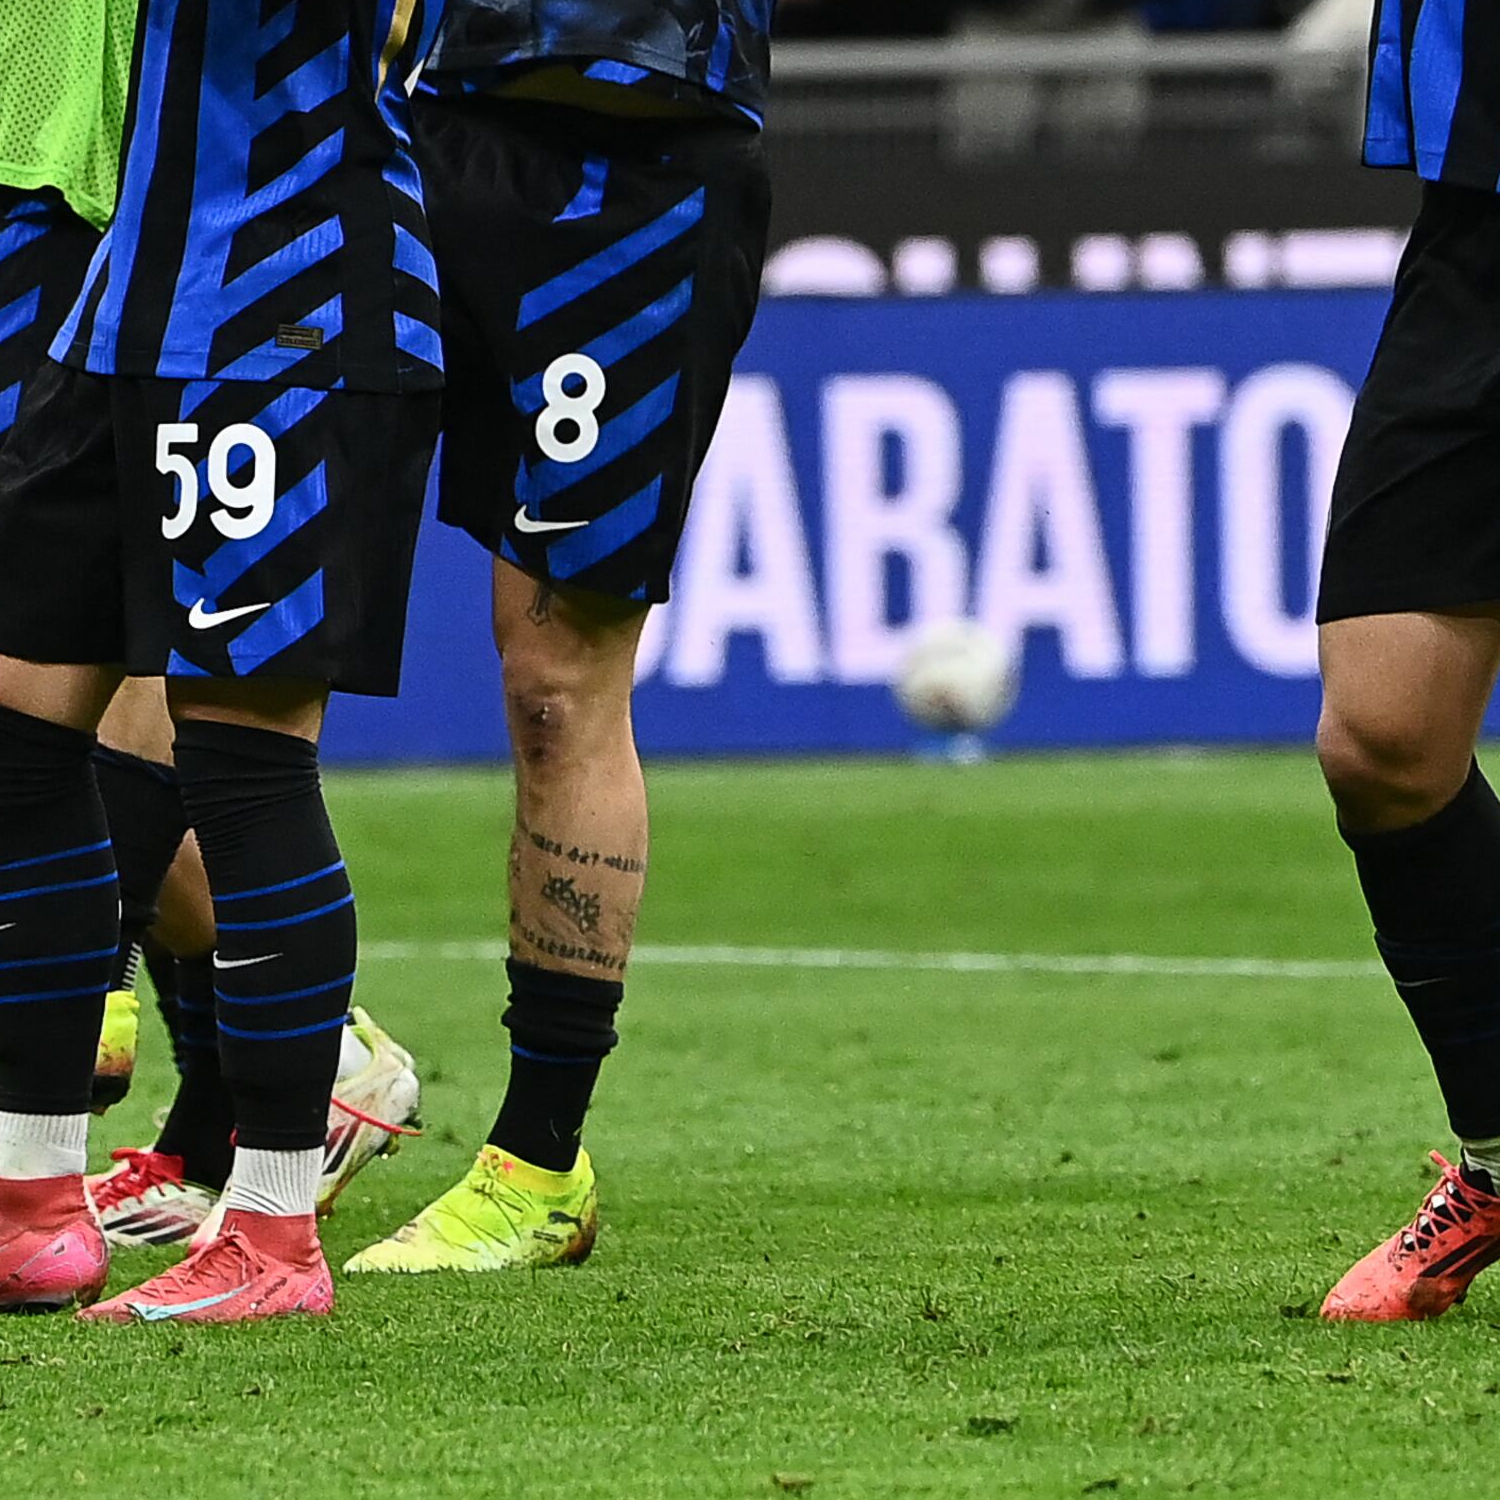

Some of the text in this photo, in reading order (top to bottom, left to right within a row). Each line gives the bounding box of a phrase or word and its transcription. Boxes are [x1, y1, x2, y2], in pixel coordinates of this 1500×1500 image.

[535, 352, 606, 463] 8
[155, 422, 276, 540] 59
[633, 361, 1357, 688] ABATO
